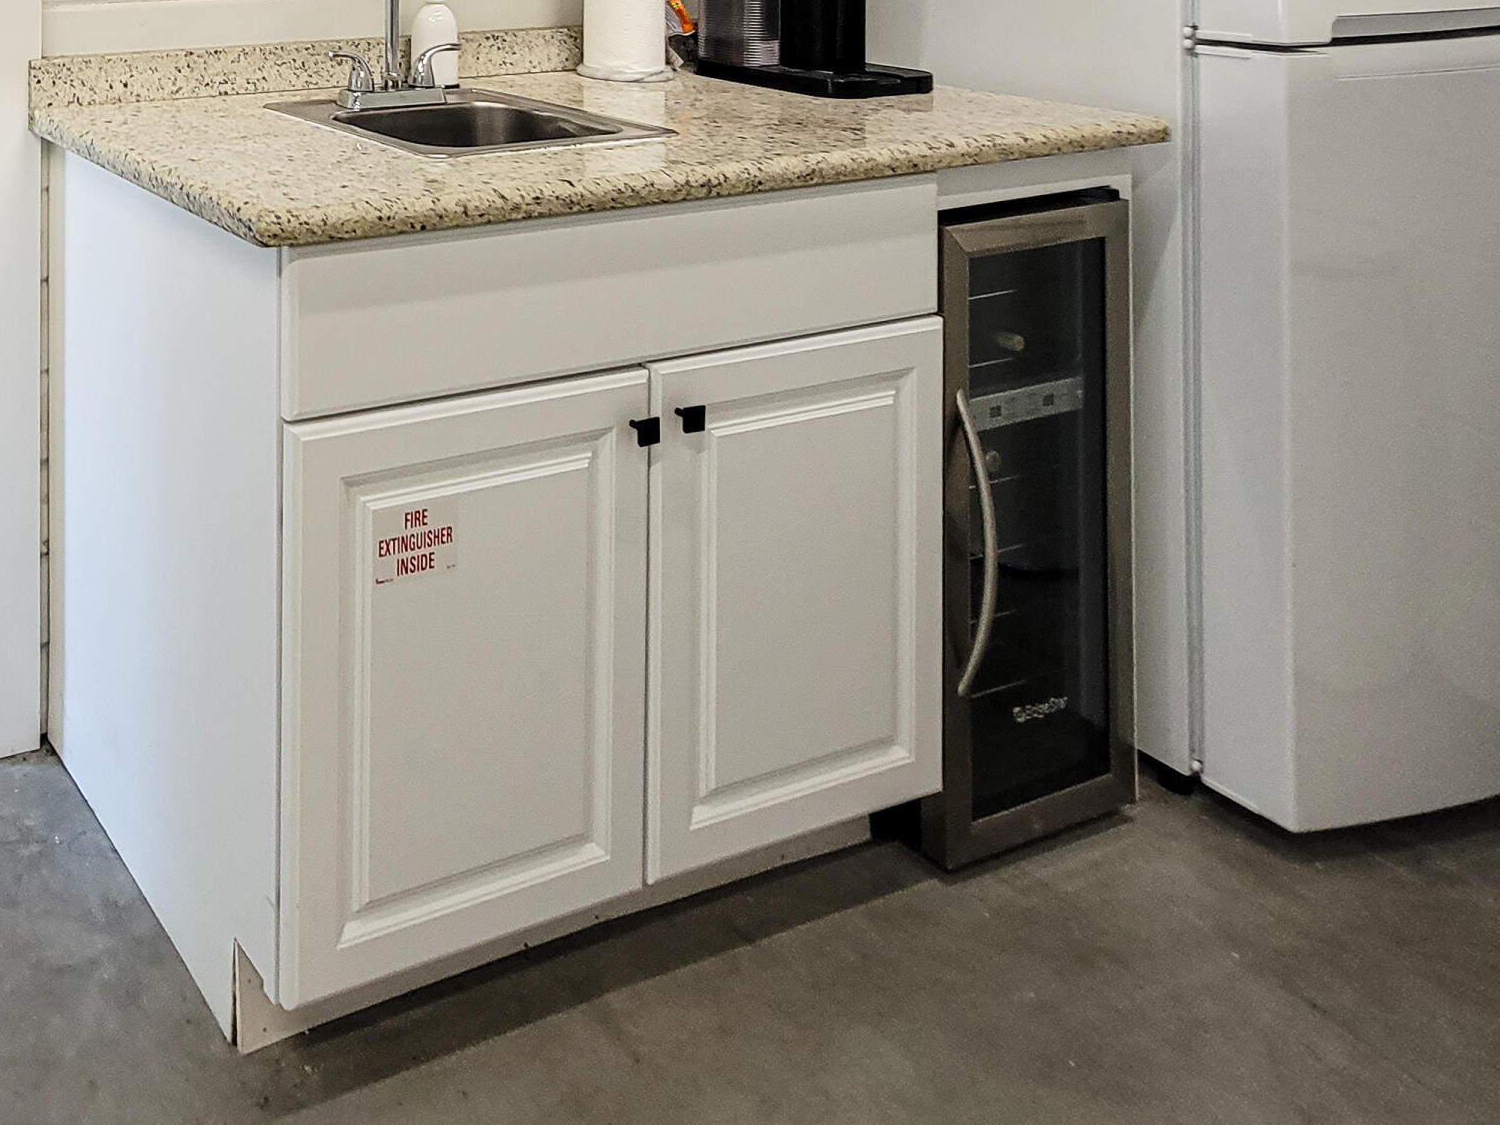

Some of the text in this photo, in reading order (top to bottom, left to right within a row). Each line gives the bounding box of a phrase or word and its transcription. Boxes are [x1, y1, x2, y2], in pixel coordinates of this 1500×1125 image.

[404, 508, 428, 530] FIRE
[378, 526, 453, 558] EXTINGUISHER
[396, 552, 435, 577] INSIDE
